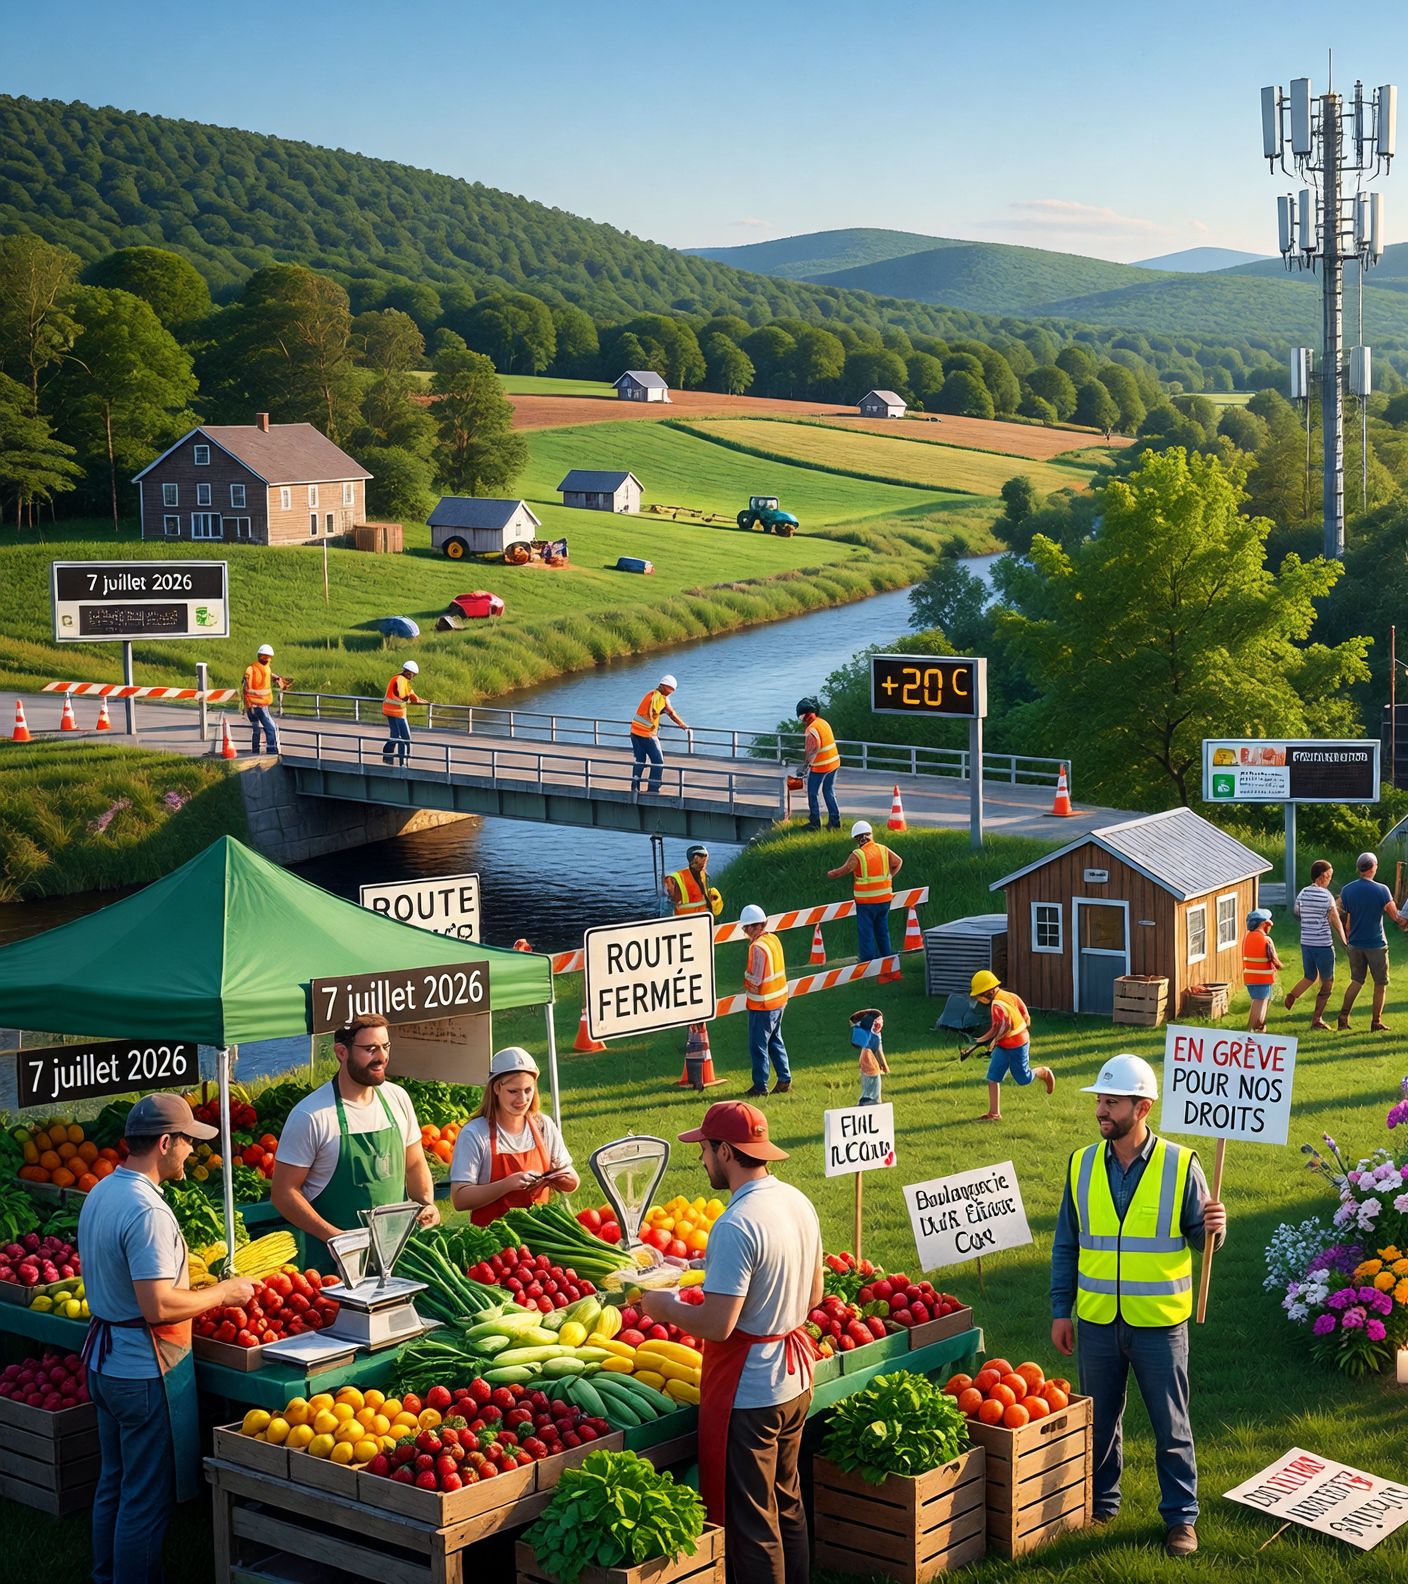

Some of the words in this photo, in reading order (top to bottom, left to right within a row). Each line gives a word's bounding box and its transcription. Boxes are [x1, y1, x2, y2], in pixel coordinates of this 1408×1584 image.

[86, 573, 98, 591] 7
[102, 573, 147, 596] juillet
[152, 573, 193, 591] 2026
[372, 886, 475, 922] ROUTE
[607, 932, 695, 975] ROUTE
[321, 986, 338, 1021] 7
[344, 979, 417, 1030] juillet
[423, 969, 484, 1009] 2026
[599, 967, 704, 1021] FERMÉE
[28, 1060, 44, 1093] 7
[51, 1053, 121, 1098] juillet
[127, 1045, 187, 1081] 2026
[1173, 1036, 1204, 1063] EN
[1212, 1036, 1287, 1072] GRÈVE
[1172, 1067, 1229, 1098] POUR
[1238, 1074, 1283, 1103] NOS
[1184, 1100, 1265, 1133] DROITS
